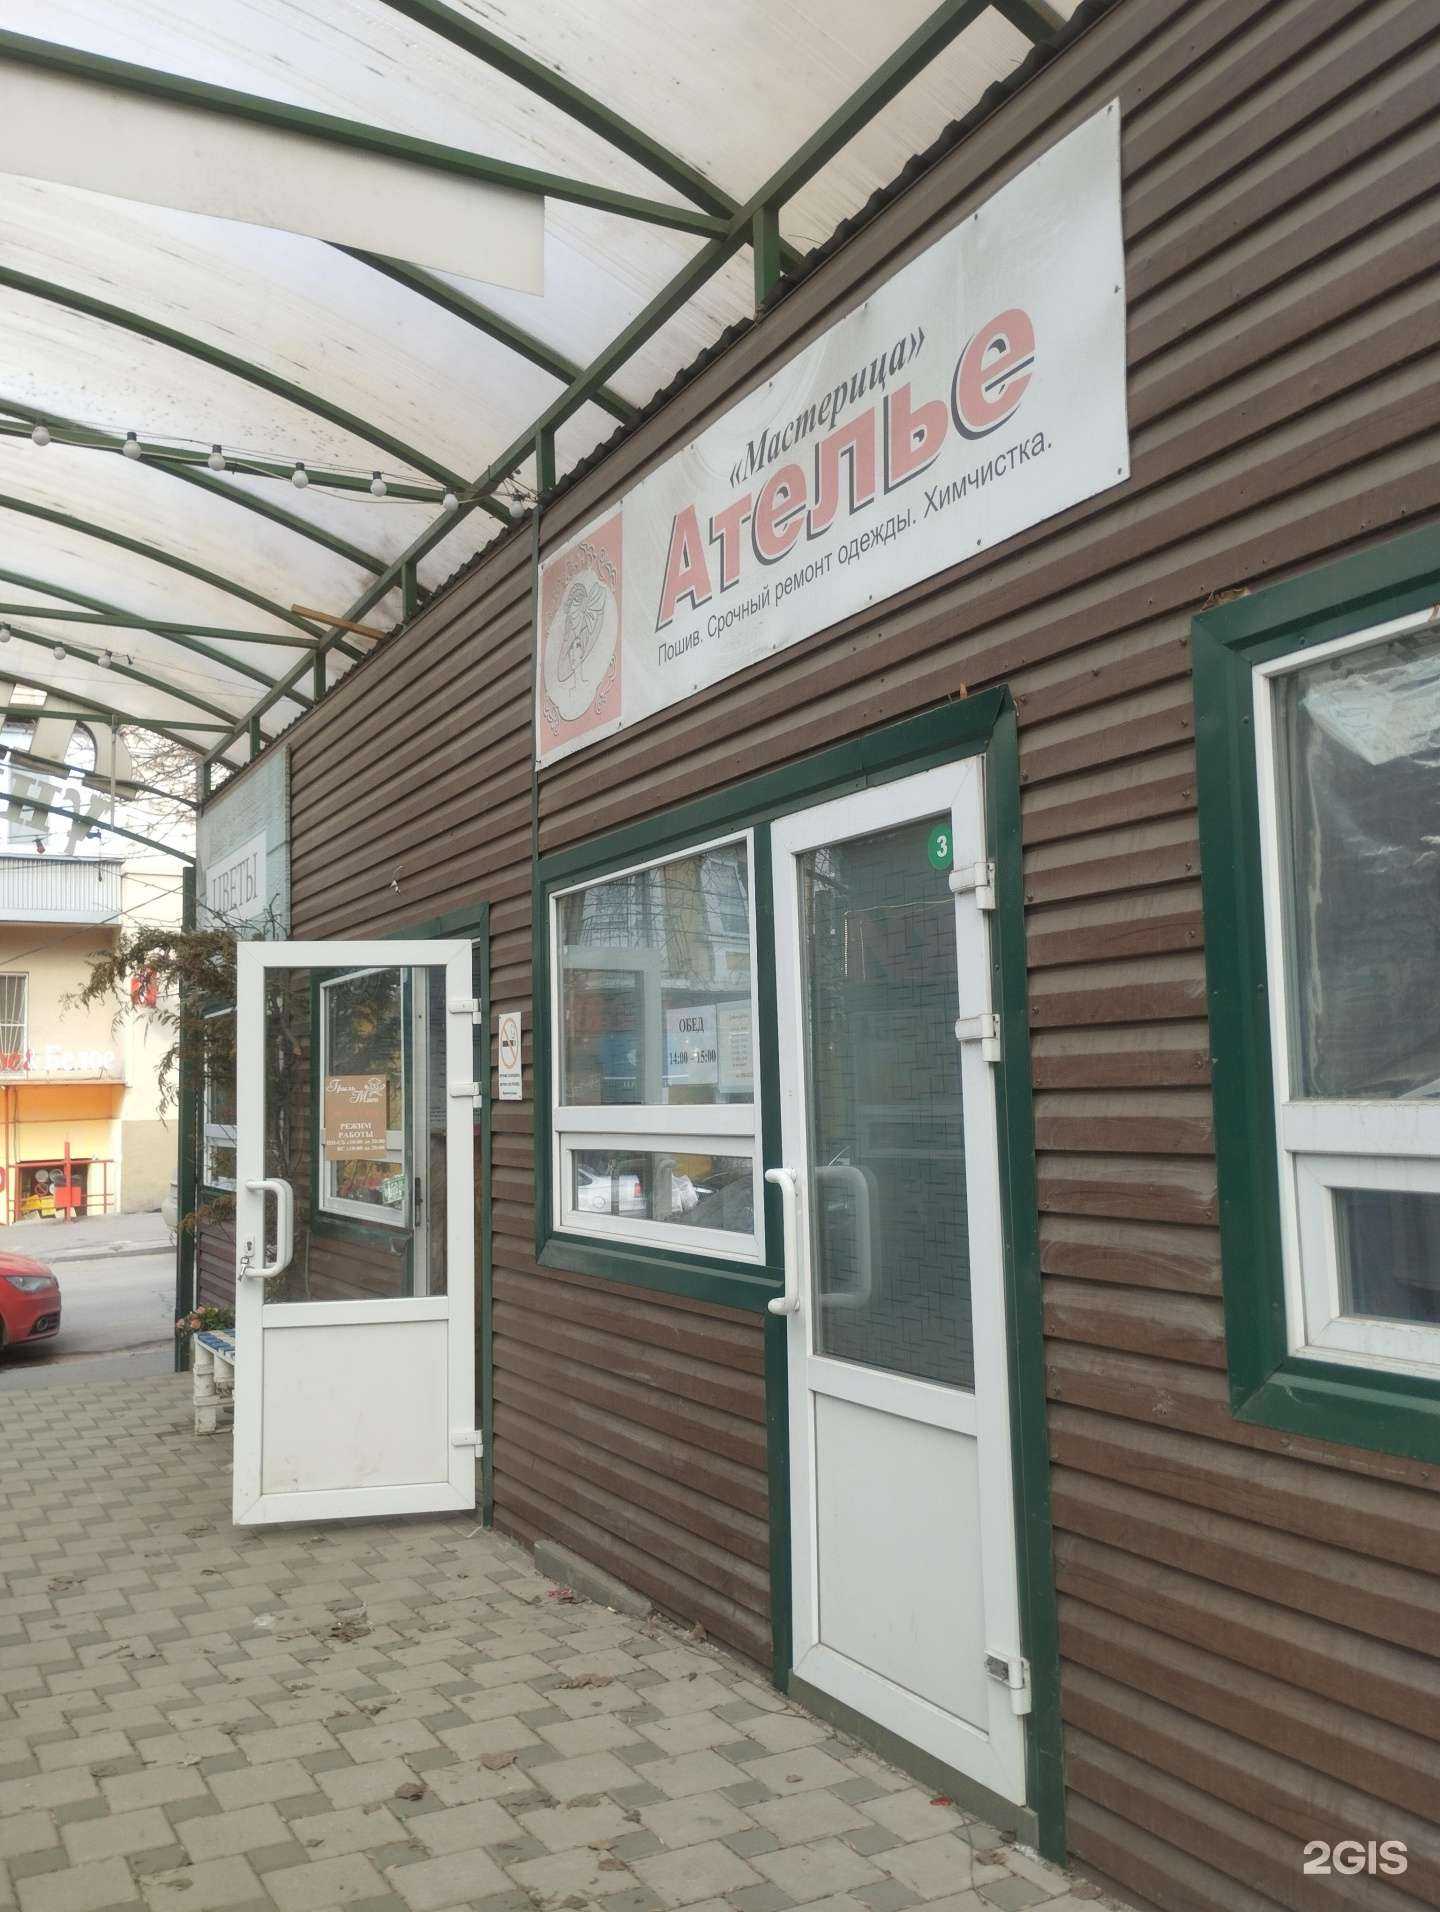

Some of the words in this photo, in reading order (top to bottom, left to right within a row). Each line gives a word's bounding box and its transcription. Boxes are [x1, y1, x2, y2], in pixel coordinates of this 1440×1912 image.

[729, 326, 925, 488] «Мастерица»
[655, 308, 1035, 633] Ателье
[658, 630, 702, 666] Пошив.
[707, 584, 771, 639] Срочный
[775, 552, 832, 606] ремонт
[838, 508, 916, 565] одежды.
[924, 431, 1052, 519] Химчистка.
[936, 835, 948, 858] 3
[211, 852, 258, 915] ЦВЕТЫ
[678, 1017, 705, 1033] ОБЕД
[669, 1050, 689, 1065] 14:00
[697, 1049, 717, 1064] 15:00
[337, 1131, 375, 1139] РАБОТЫ
[340, 1122, 372, 1131] РЕЖИМ
